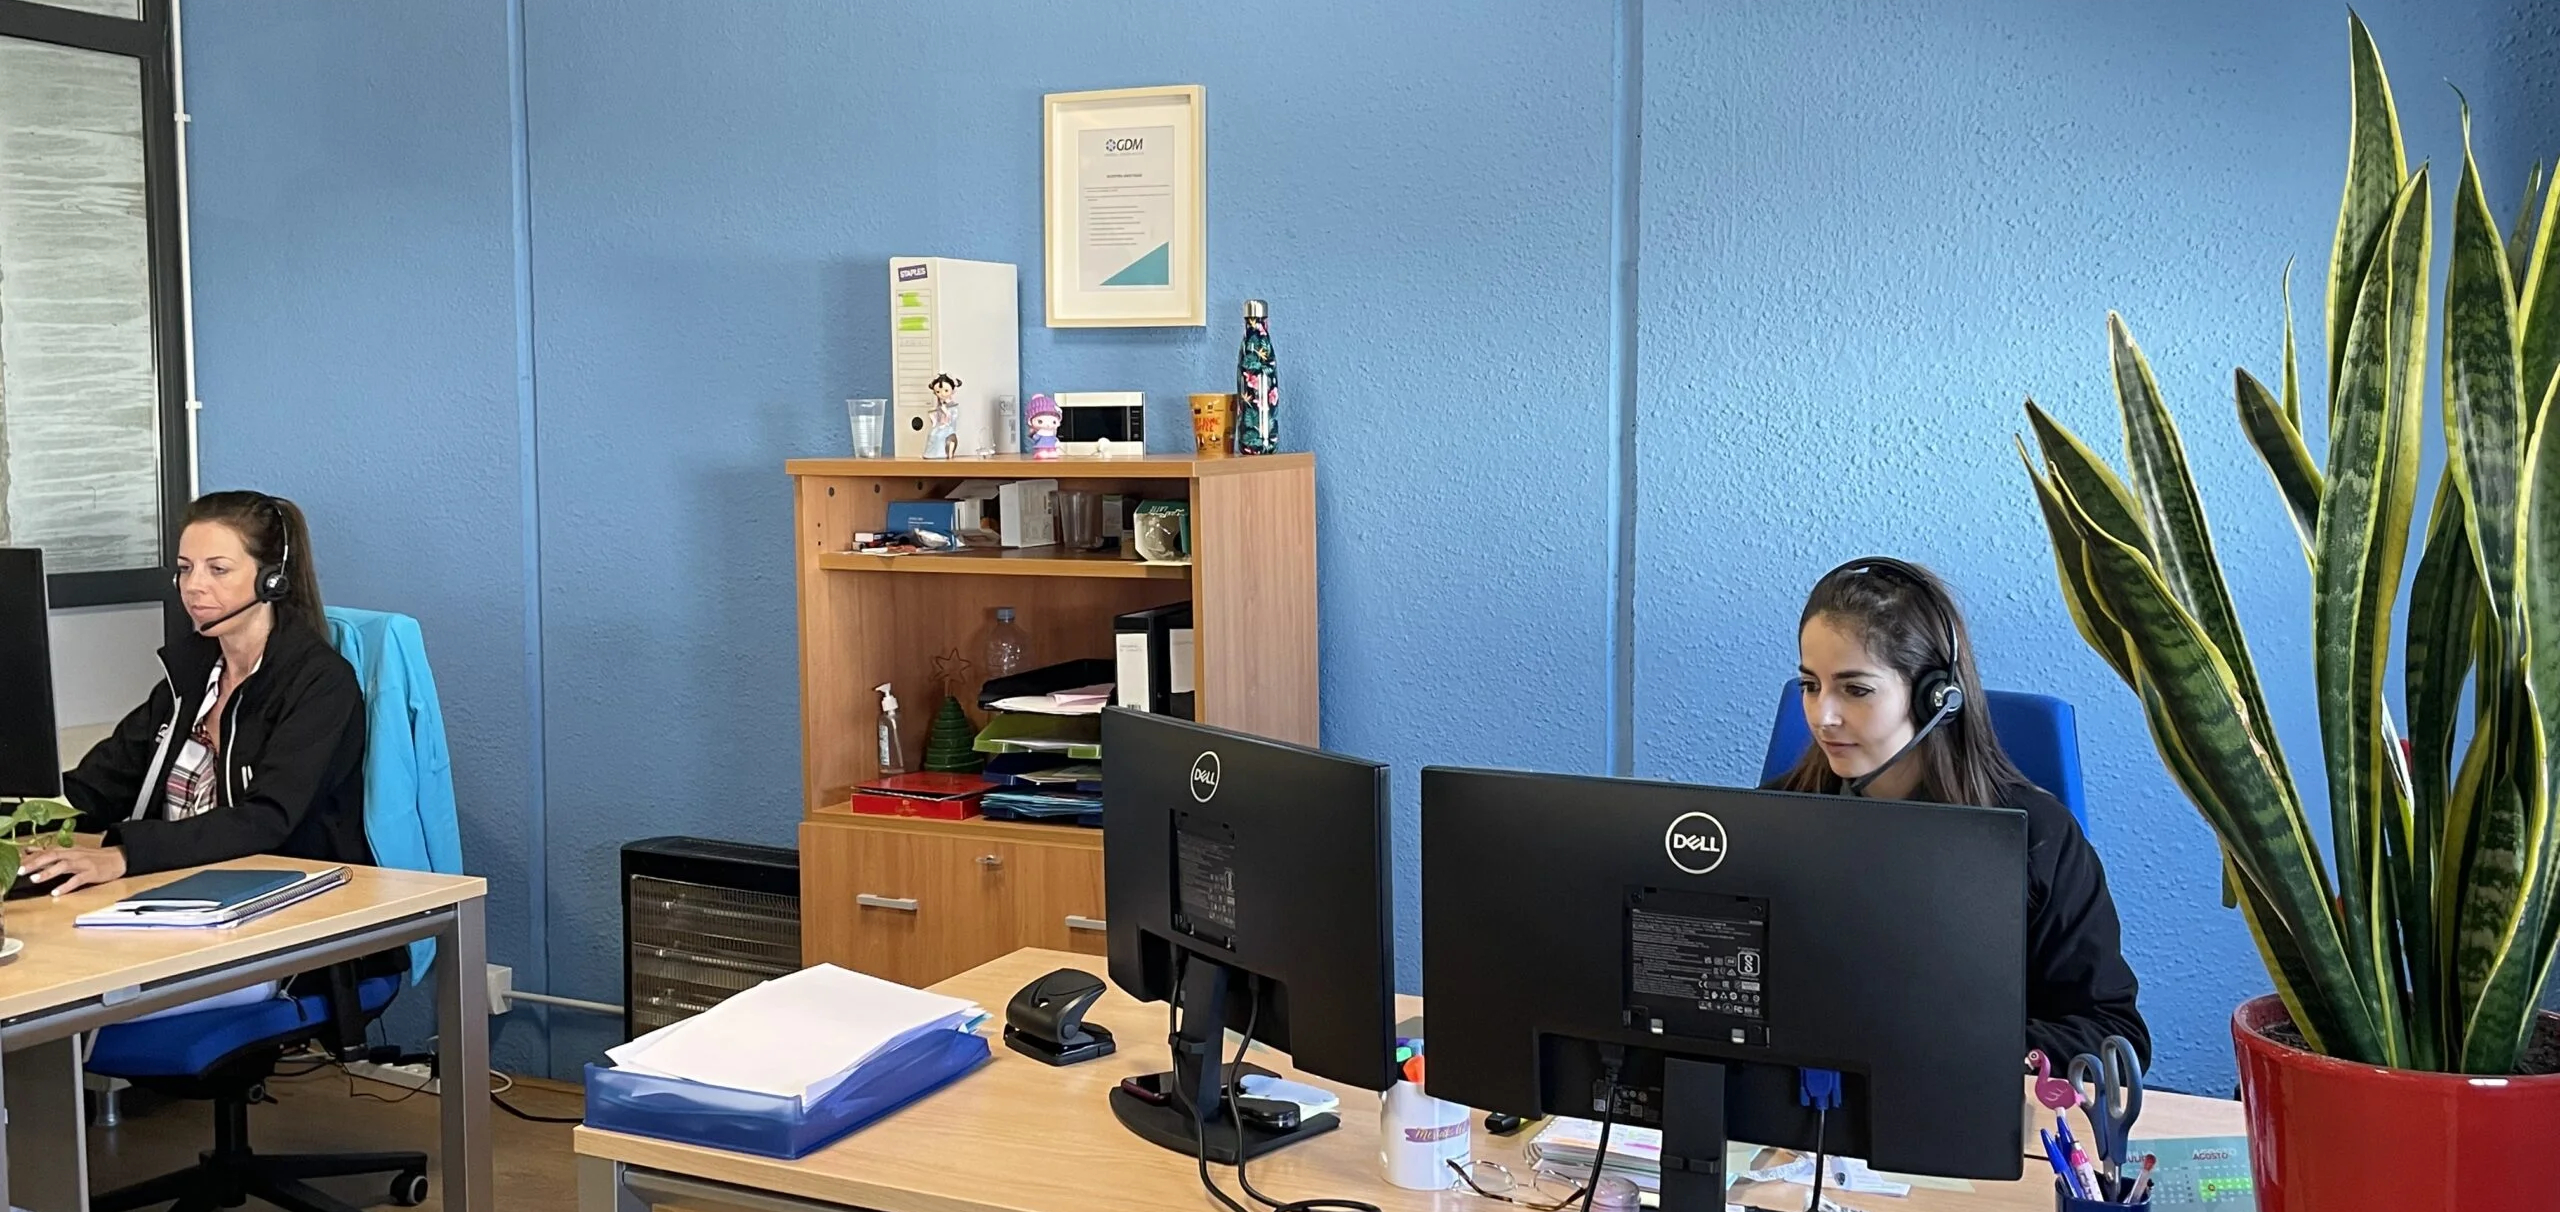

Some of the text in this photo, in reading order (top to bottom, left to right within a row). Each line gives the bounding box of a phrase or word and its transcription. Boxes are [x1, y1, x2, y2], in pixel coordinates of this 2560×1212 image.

[1116, 138, 1143, 151] GDM
[900, 267, 926, 279] STAPLES
[1194, 768, 1216, 785] DELL
[1673, 833, 1720, 853] DELL
